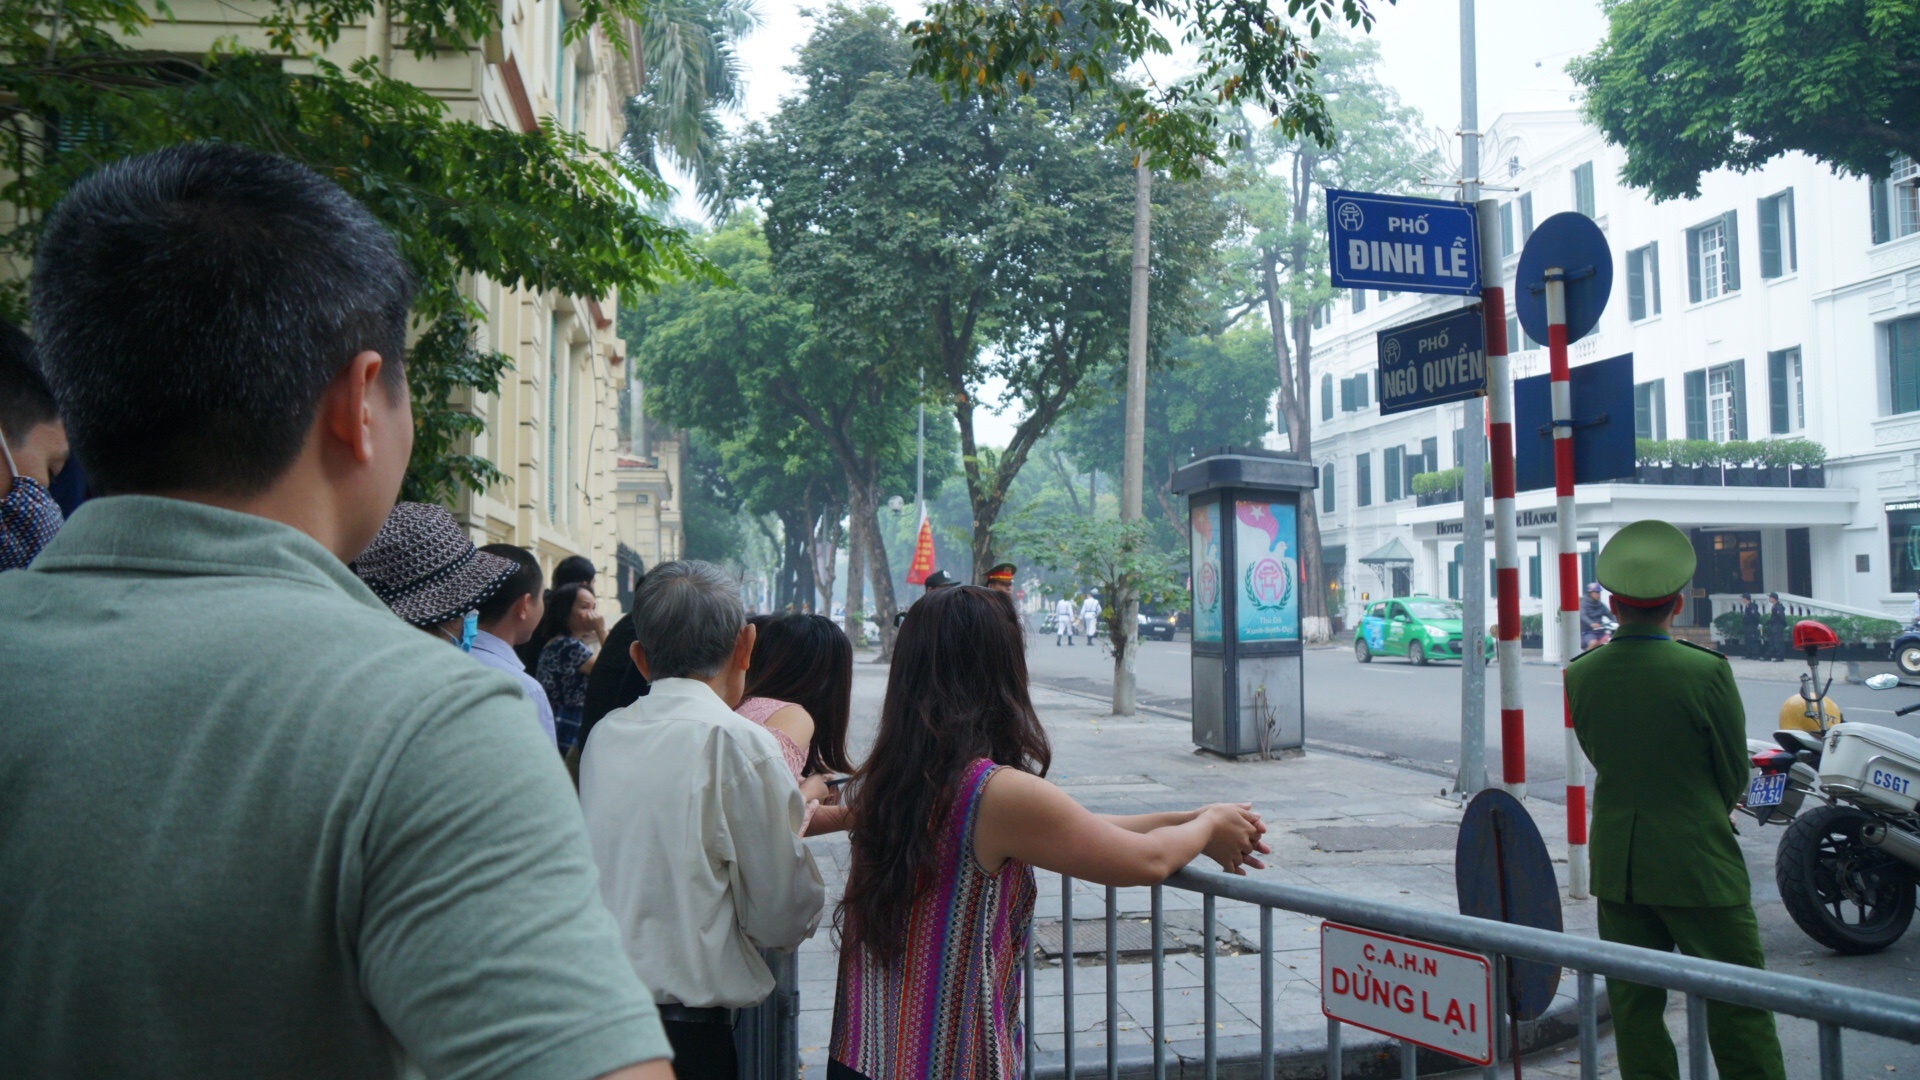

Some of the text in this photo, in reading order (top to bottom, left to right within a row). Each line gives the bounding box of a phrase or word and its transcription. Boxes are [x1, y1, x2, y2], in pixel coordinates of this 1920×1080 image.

[1388, 213, 1429, 235] PHỐ
[1348, 236, 1469, 278] ĐINH LỄ
[1418, 327, 1450, 354] PHỐ
[1384, 342, 1484, 399] NGÔ QUYỀN
[1873, 769, 1910, 795] CSGT
[1363, 943, 1437, 977] C.A.H.N
[1332, 964, 1477, 1035] DỪNG LẠI
